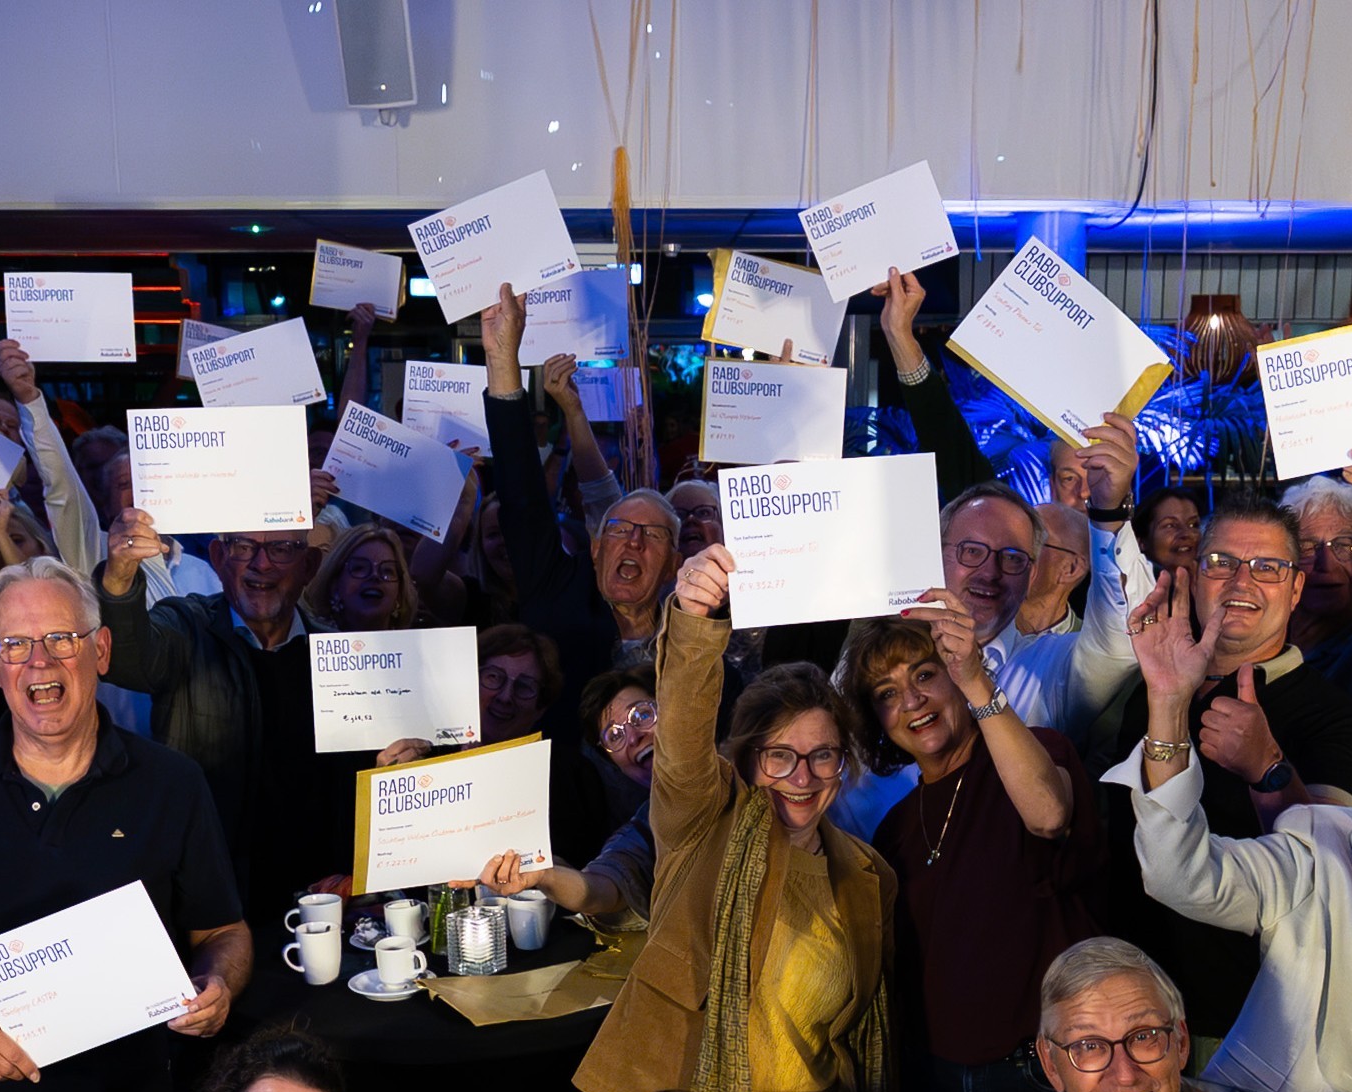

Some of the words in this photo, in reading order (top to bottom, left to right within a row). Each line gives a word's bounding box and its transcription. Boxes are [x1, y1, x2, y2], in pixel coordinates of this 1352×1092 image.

[805, 207, 833, 228] RABO
[810, 202, 877, 240] CLUBSUPPORT
[415, 219, 445, 242] RABO
[421, 215, 492, 255] CLUBSUPPORT
[319, 245, 338, 256] RABO
[318, 255, 363, 269] CLUBSUPPORT
[734, 256, 759, 274] RABO
[1025, 245, 1060, 279] RABO
[9, 277, 34, 289] RABO
[731, 270, 793, 297] CLUBSUPPORT
[9, 289, 74, 301] CLUBSUPPORT
[1014, 260, 1095, 330] CLUBSUPPORT
[193, 348, 217, 363] RABO
[196, 349, 256, 375] CLUBSUPPORT
[1266, 352, 1303, 373] RABO
[410, 365, 433, 377] RABO
[712, 367, 740, 381] RABO
[408, 378, 470, 394] CLUBSUPPORT
[712, 380, 783, 397] CLUBSUPPORT
[134, 416, 169, 432] RABO
[349, 407, 376, 429] RABO
[136, 431, 225, 450] CLUBSUPPORT
[344, 419, 412, 459] CLUBSUPPORT
[728, 474, 771, 497] RABO
[730, 491, 840, 520] CLUBSUPPORT
[316, 639, 349, 656] RABO
[317, 653, 403, 673] CLUBSUPPORT
[379, 775, 416, 797] RABO
[378, 783, 473, 815] CLUBSUPPORT
